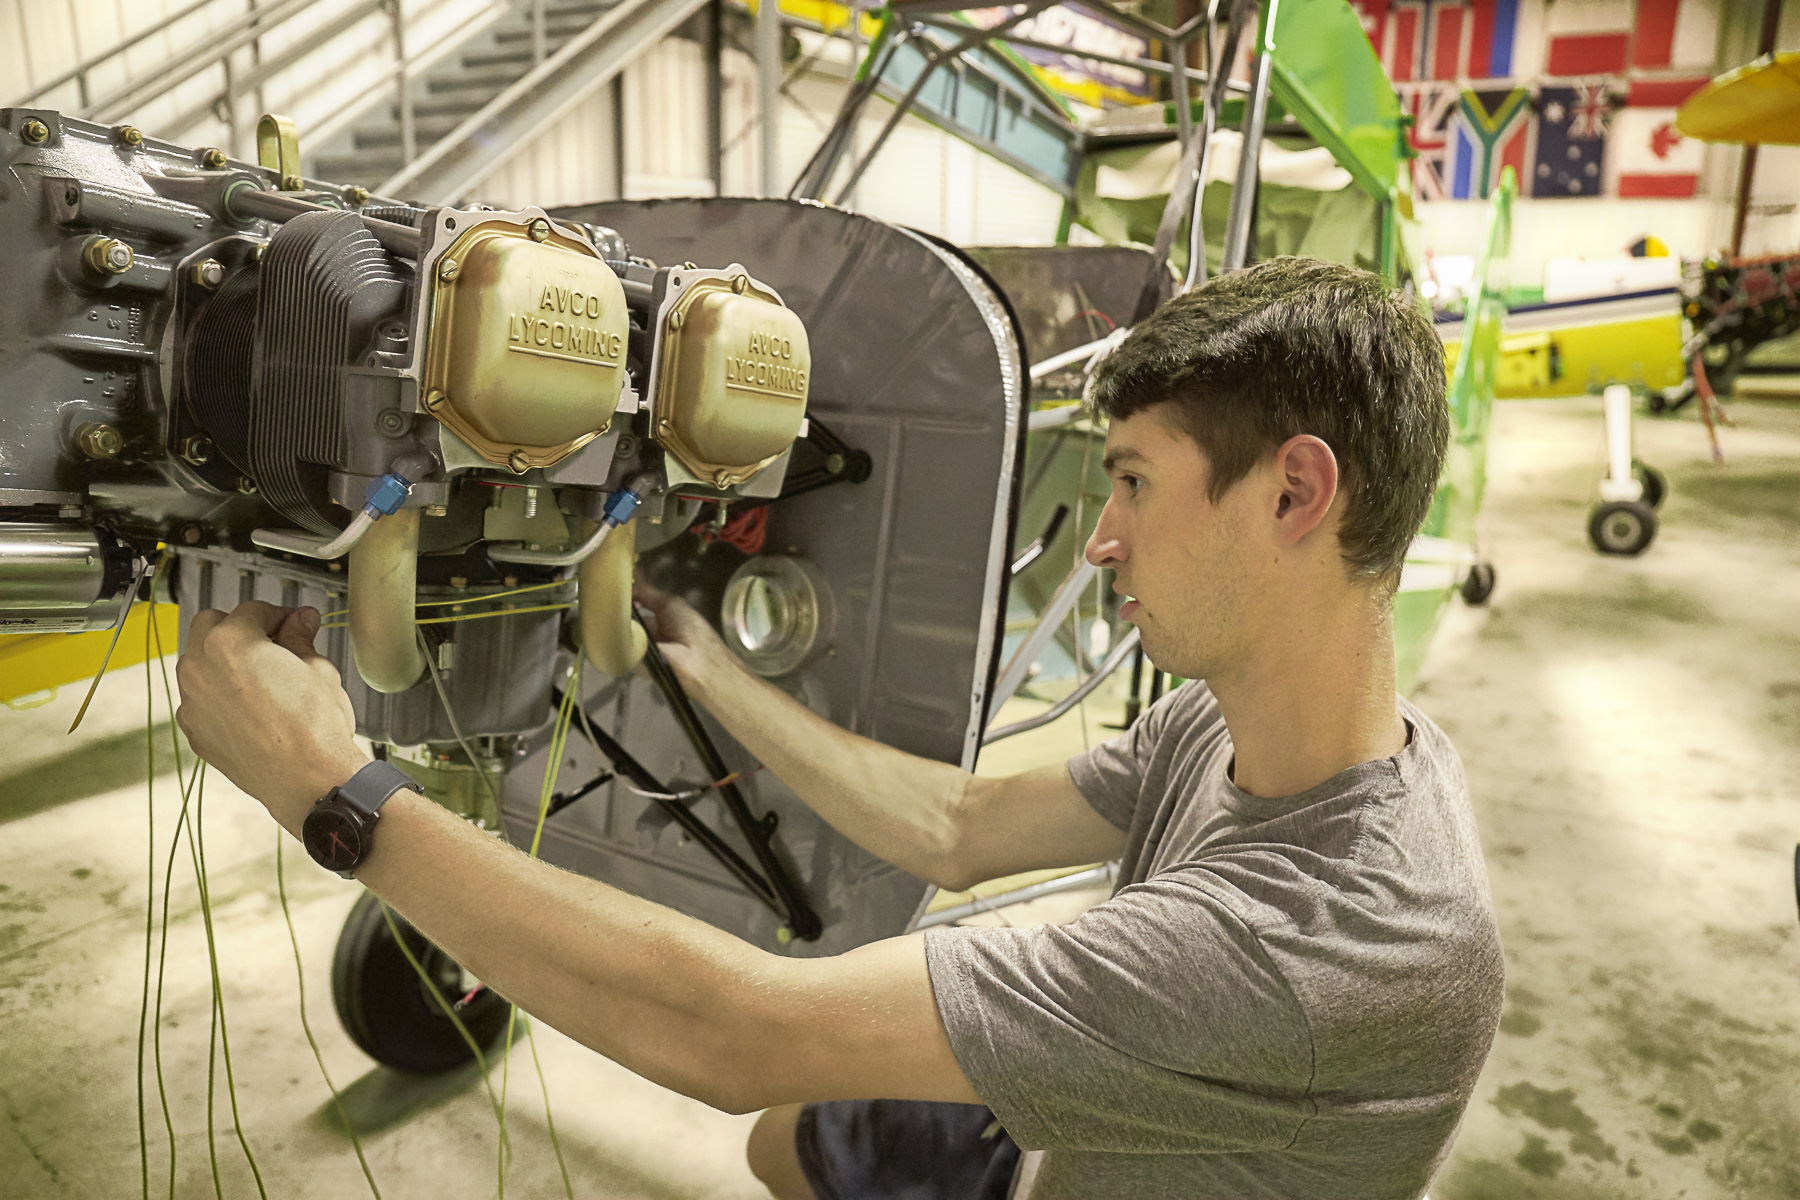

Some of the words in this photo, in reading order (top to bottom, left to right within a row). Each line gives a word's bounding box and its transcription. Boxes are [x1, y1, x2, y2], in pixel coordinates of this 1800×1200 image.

[540, 283, 600, 319] AVCO
[509, 313, 621, 359] LYCOMING
[748, 330, 791, 360] AVCO
[726, 356, 806, 393] LYCOMING
